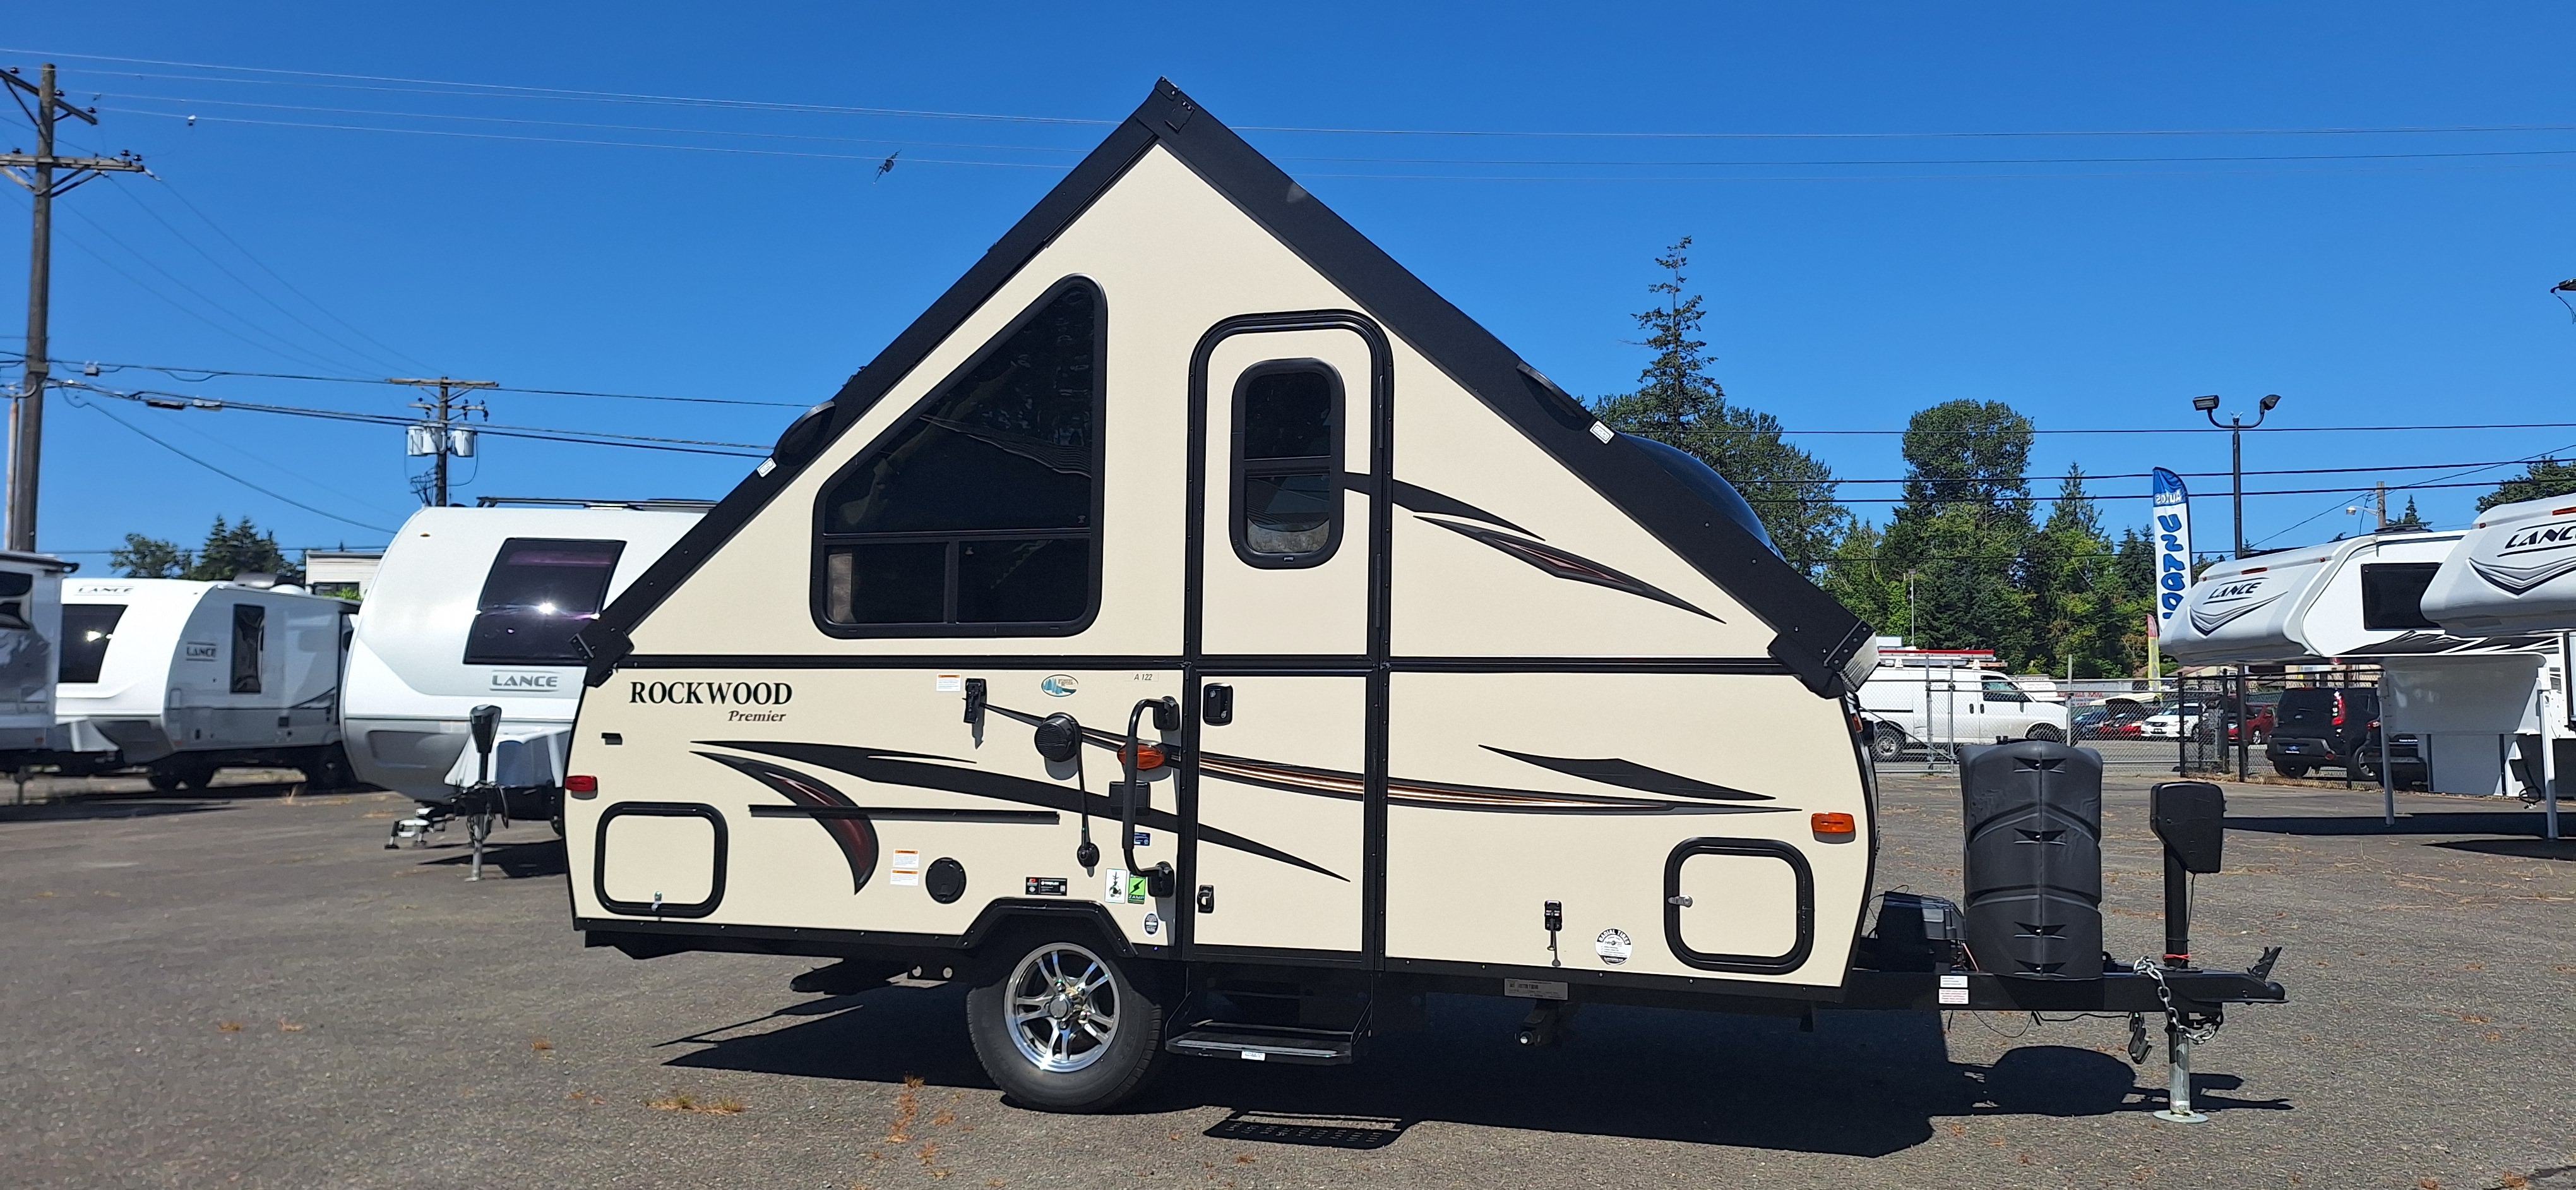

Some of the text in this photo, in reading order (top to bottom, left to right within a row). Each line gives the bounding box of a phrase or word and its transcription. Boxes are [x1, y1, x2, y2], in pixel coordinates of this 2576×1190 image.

[2505, 526, 2576, 549] LANC
[2207, 582, 2262, 599] LANCE
[187, 646, 216, 658] LANCE
[492, 675, 559, 687] LANCE
[629, 681, 793, 706] ROCKWOOD
[727, 709, 787, 722] Premier
[1598, 929, 1630, 944] RADIAL TIRES
